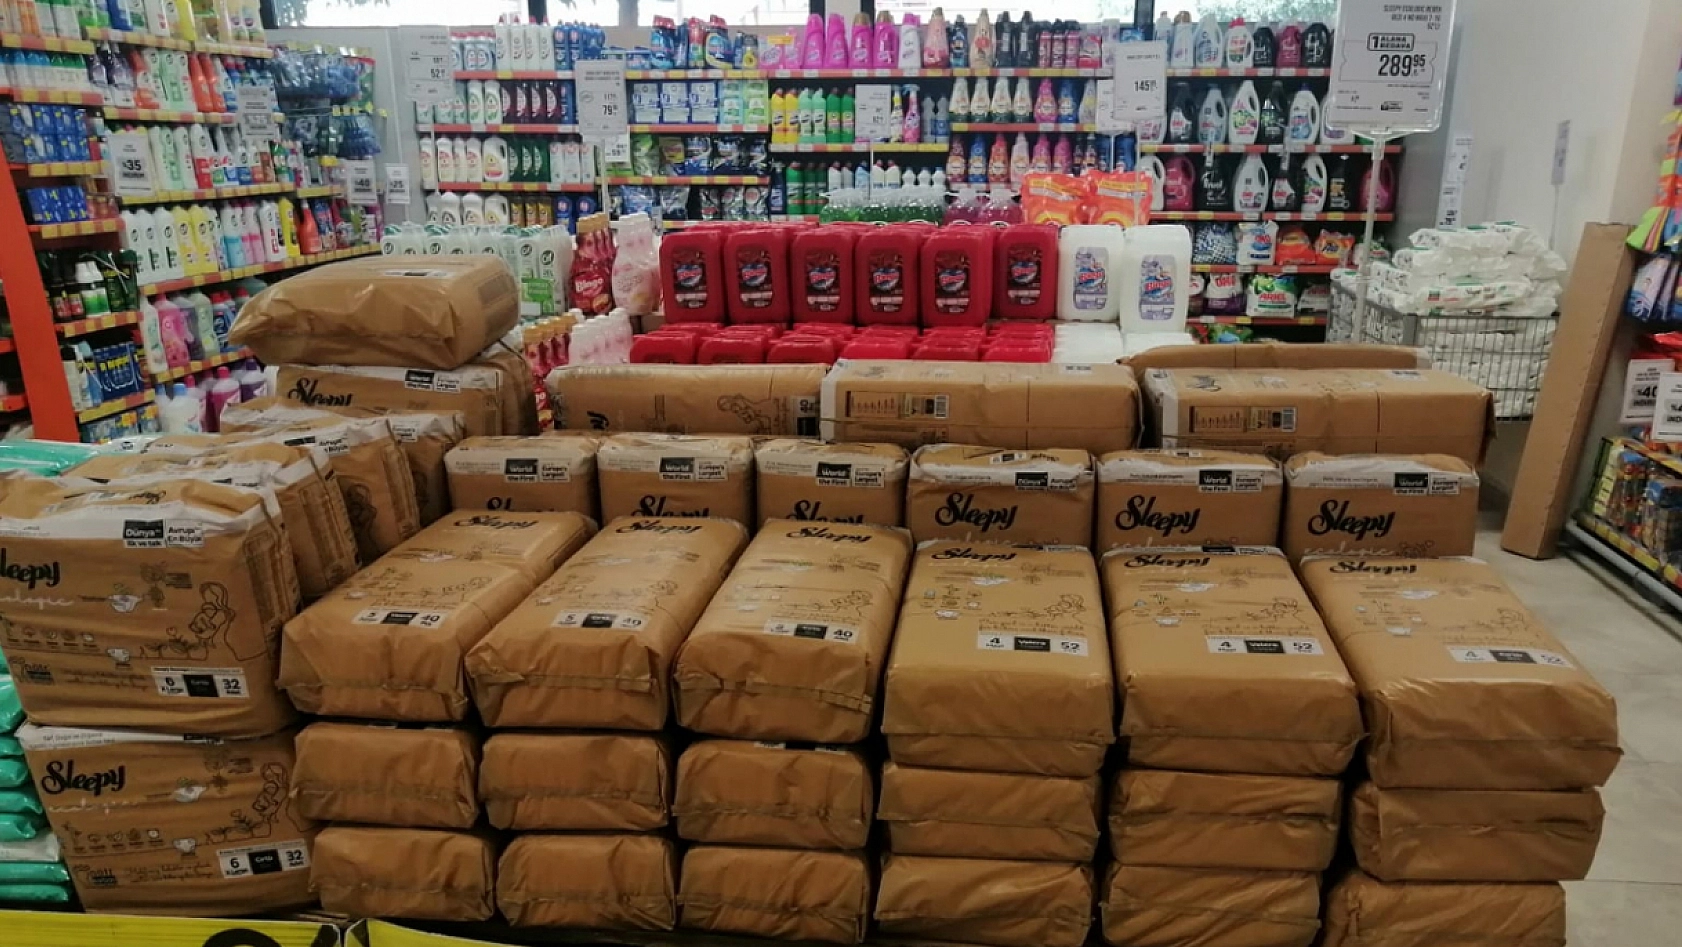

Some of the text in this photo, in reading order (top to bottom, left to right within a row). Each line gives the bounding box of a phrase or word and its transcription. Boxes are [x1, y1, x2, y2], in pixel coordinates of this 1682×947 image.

[1372, 36, 1379, 49] 1
[1378, 54, 1426, 76] 289 95
[575, 278, 604, 294] Bingo
[935, 492, 1018, 532] Sleepy
[1116, 495, 1201, 537] Sleepy
[1308, 500, 1396, 541] Sleepy
[0, 548, 60, 590] leepy
[834, 629, 853, 637] 40
[221, 678, 242, 690] 32
[42, 759, 125, 797] Sleepy
[230, 857, 240, 868] 6
[286, 850, 304, 861] 32
